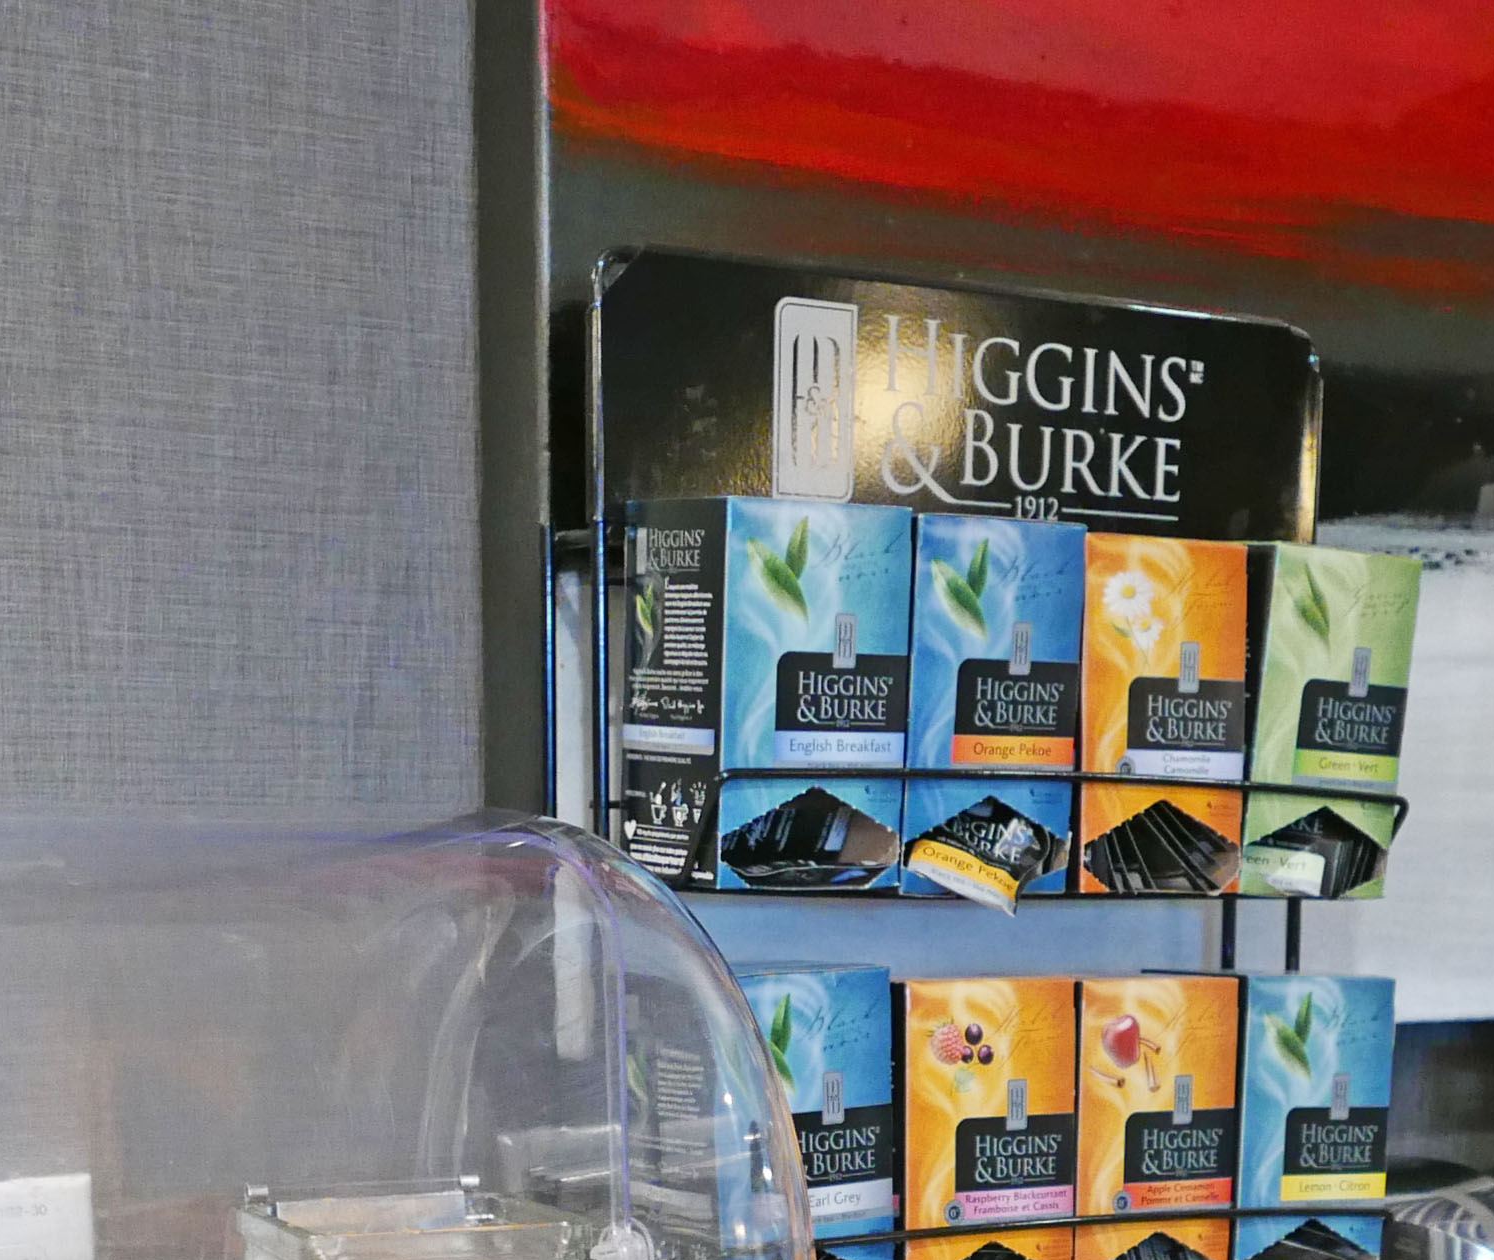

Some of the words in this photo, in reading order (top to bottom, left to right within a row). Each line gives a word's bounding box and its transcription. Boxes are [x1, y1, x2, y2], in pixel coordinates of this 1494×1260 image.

[884, 315, 1187, 422] HIGGINS
[881, 402, 954, 504] &
[960, 408, 1182, 502] BURKE
[1014, 496, 1060, 521] 1912
[798, 671, 890, 696] HIGGINS
[977, 677, 1060, 702] HIGGINS
[797, 695, 819, 723] &
[820, 696, 887, 720] BURKE
[974, 700, 995, 729] &
[996, 701, 1057, 725] BURKE
[1148, 695, 1228, 719] HIGGINS
[1318, 697, 1393, 724] HIGGINS
[1146, 716, 1166, 744] &
[1167, 717, 1226, 741] BURKE
[1315, 718, 1333, 744] &
[1334, 720, 1389, 744] BURKE
[789, 738, 832, 756] English
[836, 738, 892, 753] Breakfast
[973, 742, 1016, 759] Orange
[1019, 743, 1052, 757] Pekoe
[1318, 756, 1351, 771] Green
[1358, 761, 1379, 773] Vert
[922, 846, 975, 872] Orange
[978, 864, 1014, 891] Pekoe
[975, 1135, 1059, 1157] HIGGINS
[1143, 1128, 1220, 1149] HIGGINS
[1301, 1123, 1375, 1144] HIGGINS
[813, 1149, 876, 1175] BURKE
[1142, 1150, 1161, 1175] &
[1162, 1149, 1218, 1170] BURKE
[1300, 1144, 1318, 1168] &
[1319, 1143, 1372, 1163] BURKE
[975, 1157, 996, 1183] &
[996, 1156, 1056, 1178] BURKE
[965, 1193, 1011, 1204] Raspberry
[1299, 1181, 1331, 1192] Lemon
[1339, 1180, 1370, 1192] Citron
[808, 1192, 831, 1208] Earl
[834, 1191, 861, 1206] Grey
[1033, 1200, 1059, 1211] Cassis
